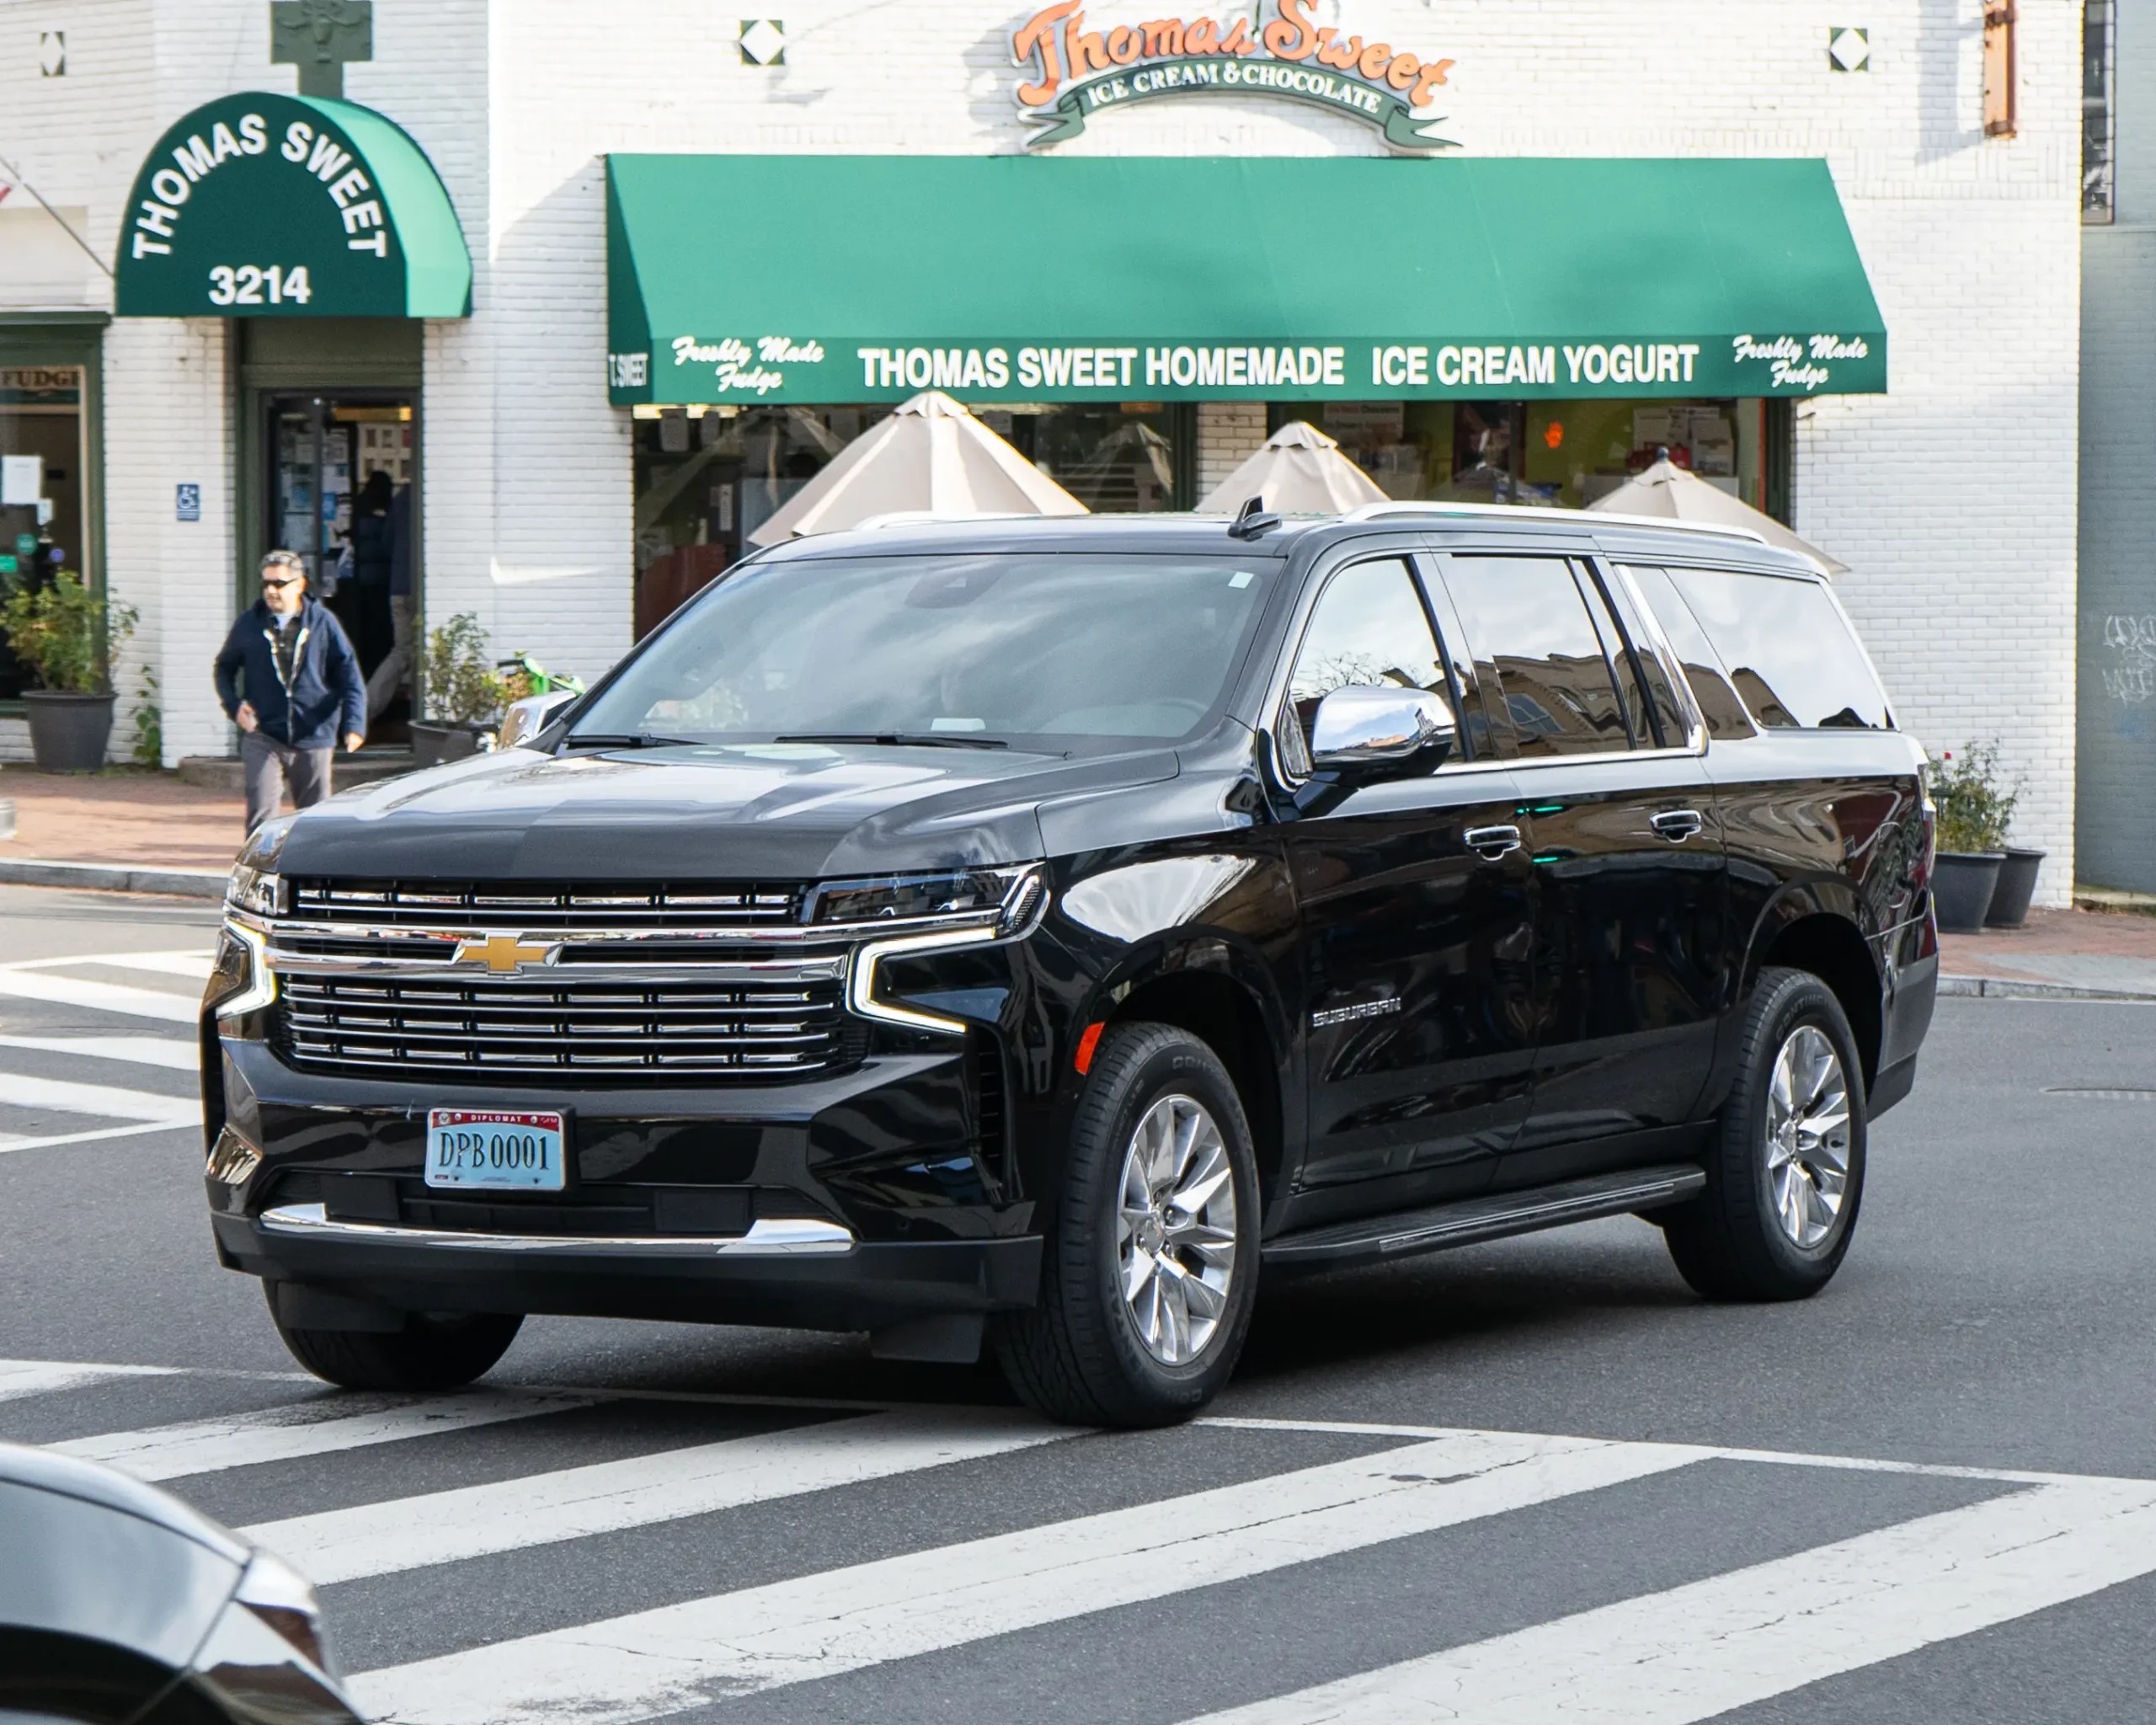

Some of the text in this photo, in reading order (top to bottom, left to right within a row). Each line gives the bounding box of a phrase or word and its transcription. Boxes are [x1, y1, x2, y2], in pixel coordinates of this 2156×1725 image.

[1014, 0, 1455, 107] Thomas Sweet
[1086, 61, 1383, 115] ICE CREAM & CHOCOLATE
[132, 114, 387, 259] THOMAS SWEET
[208, 265, 312, 305] 3214
[671, 335, 825, 367] Freshly Made
[857, 344, 1700, 388] THOMAS SWEET HOMEMADE ICE CREAM YOGURT
[1732, 334, 1868, 365] Freshly Made
[716, 362, 783, 396] Fudge
[1770, 359, 1829, 391] Fudge
[1313, 996, 1401, 1028] SUBURBAN
[471, 1114, 522, 1123] DIPLOMAT
